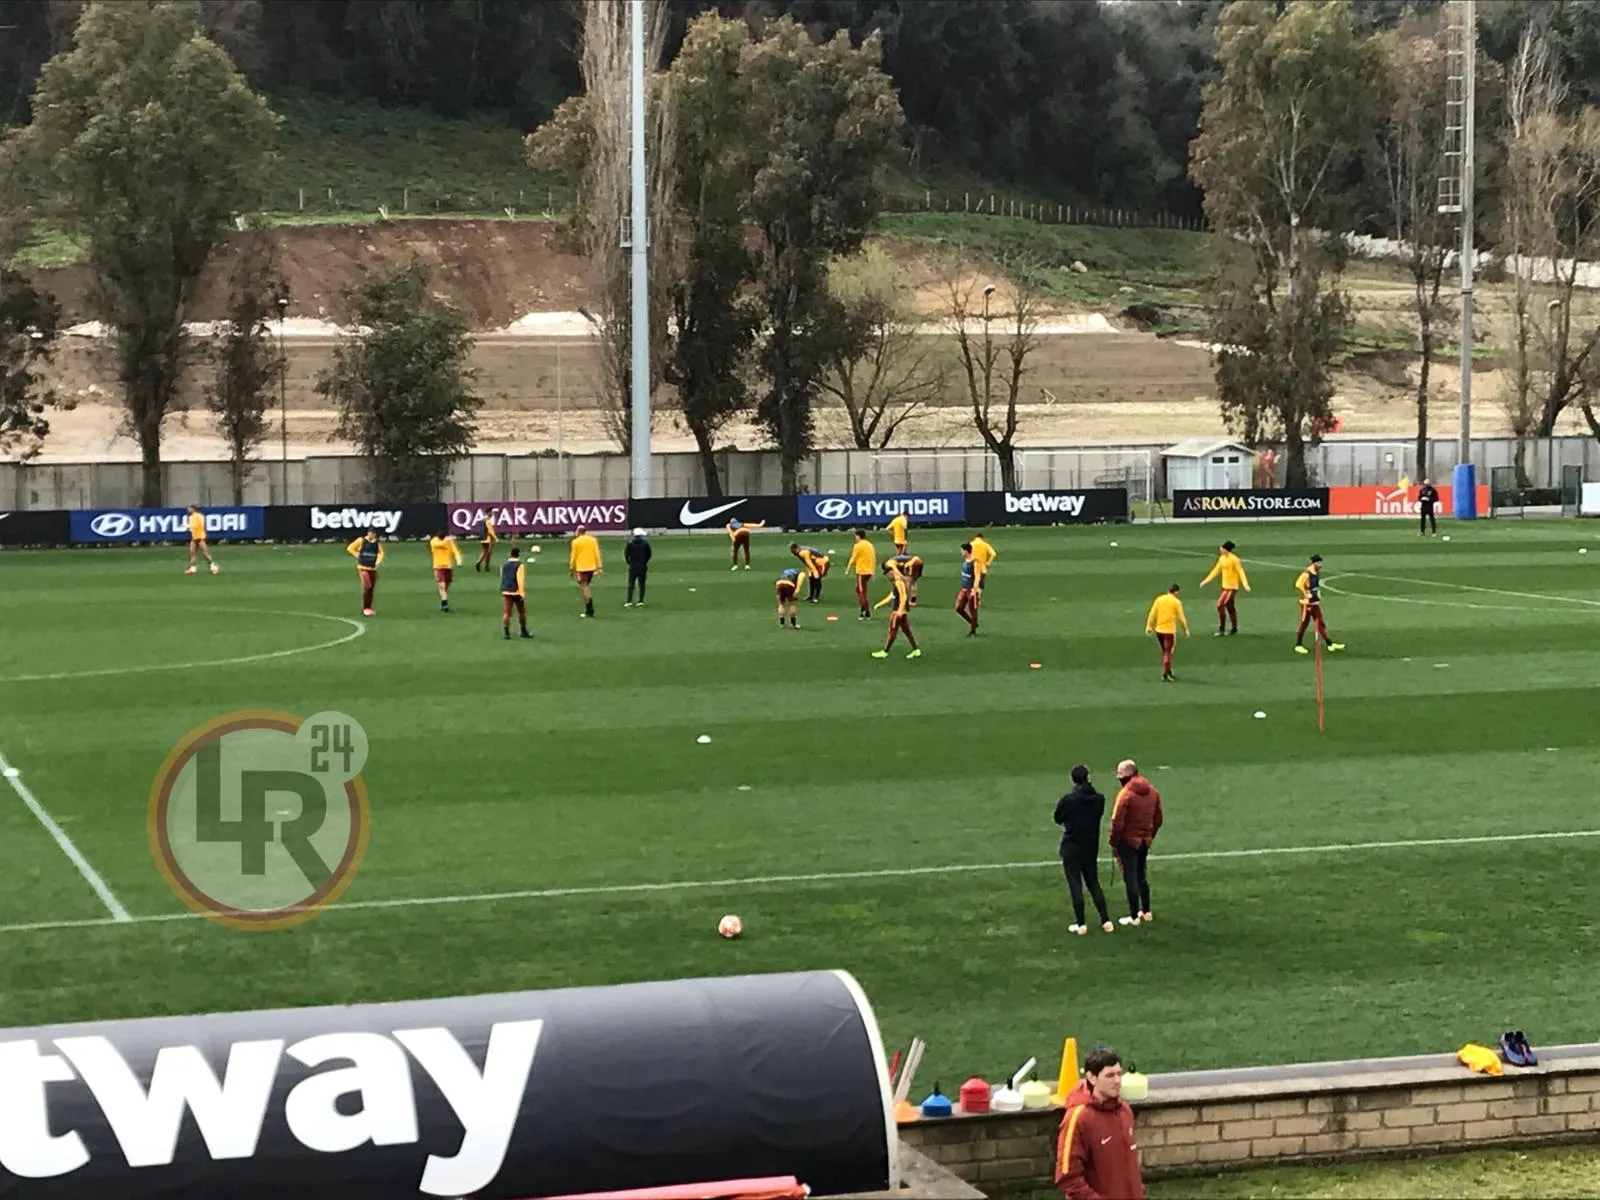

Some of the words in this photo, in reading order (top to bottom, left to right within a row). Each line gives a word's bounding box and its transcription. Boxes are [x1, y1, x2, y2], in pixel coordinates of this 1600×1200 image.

[856, 498, 949, 516] HYUNDAI
[1005, 492, 1085, 516] betway
[139, 513, 246, 533] HYUDAI
[311, 506, 401, 533] betway
[452, 507, 528, 530] QATAR
[531, 504, 626, 526] AIRWAYS
